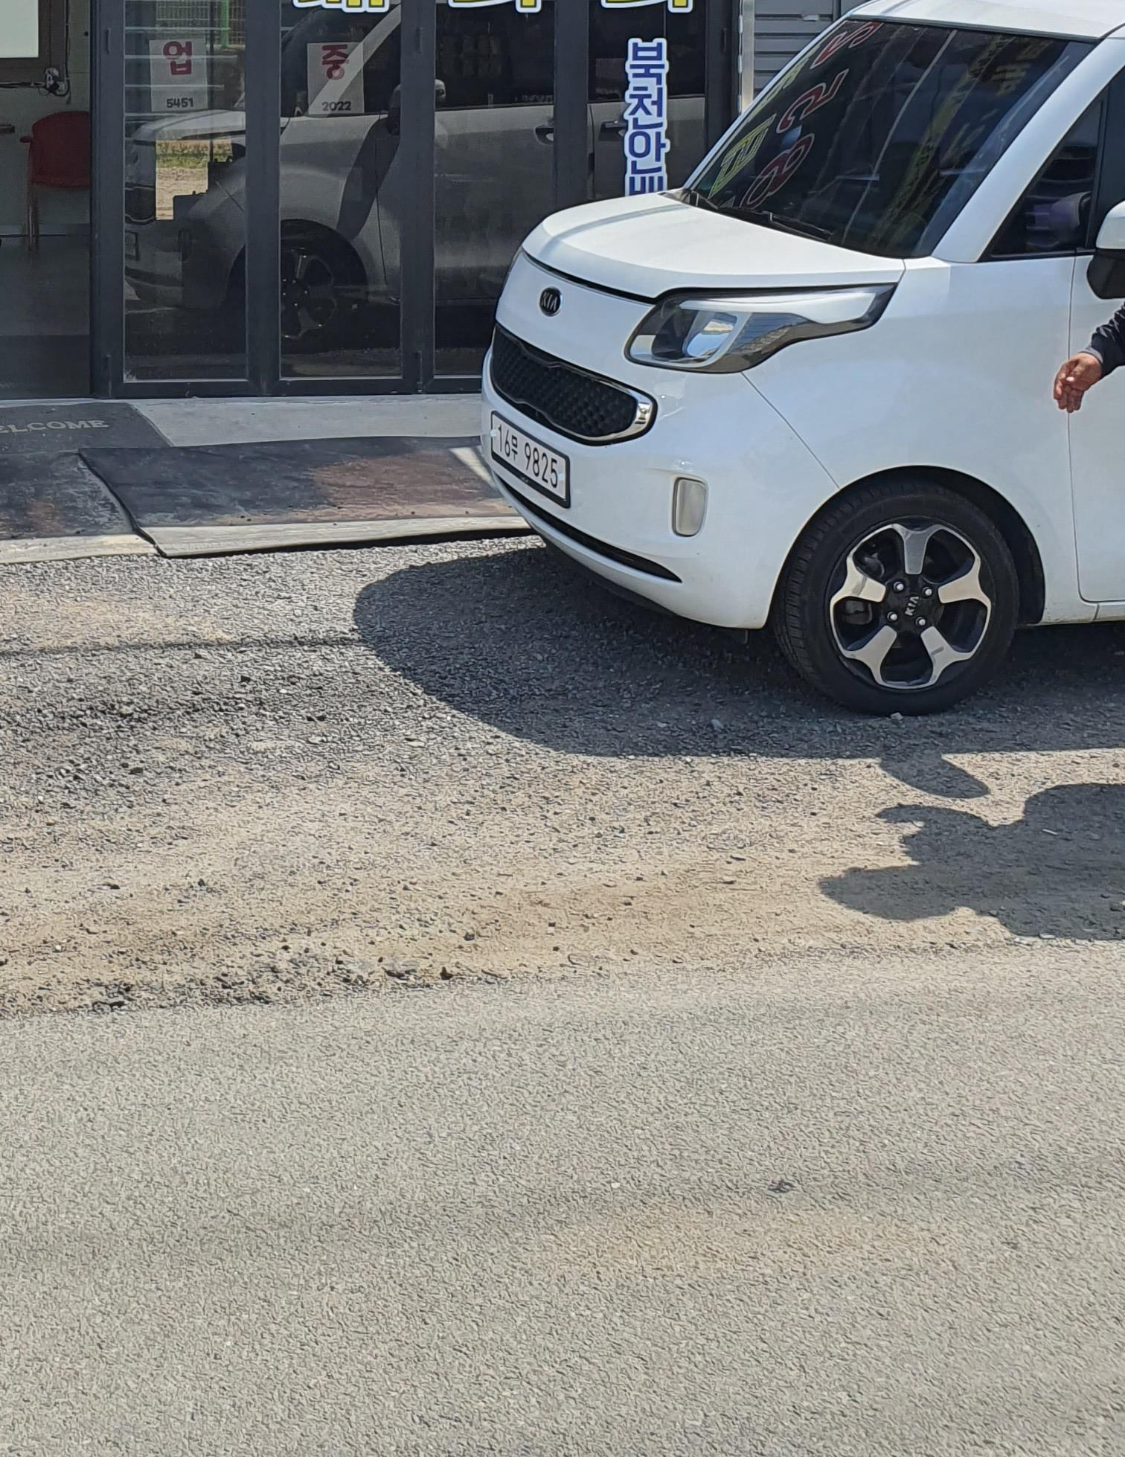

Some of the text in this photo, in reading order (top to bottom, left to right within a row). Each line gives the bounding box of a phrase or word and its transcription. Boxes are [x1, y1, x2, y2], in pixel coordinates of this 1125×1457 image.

[321, 100, 352, 112] 2022
[540, 291, 559, 311] KIA
[523, 441, 559, 490] 9825
